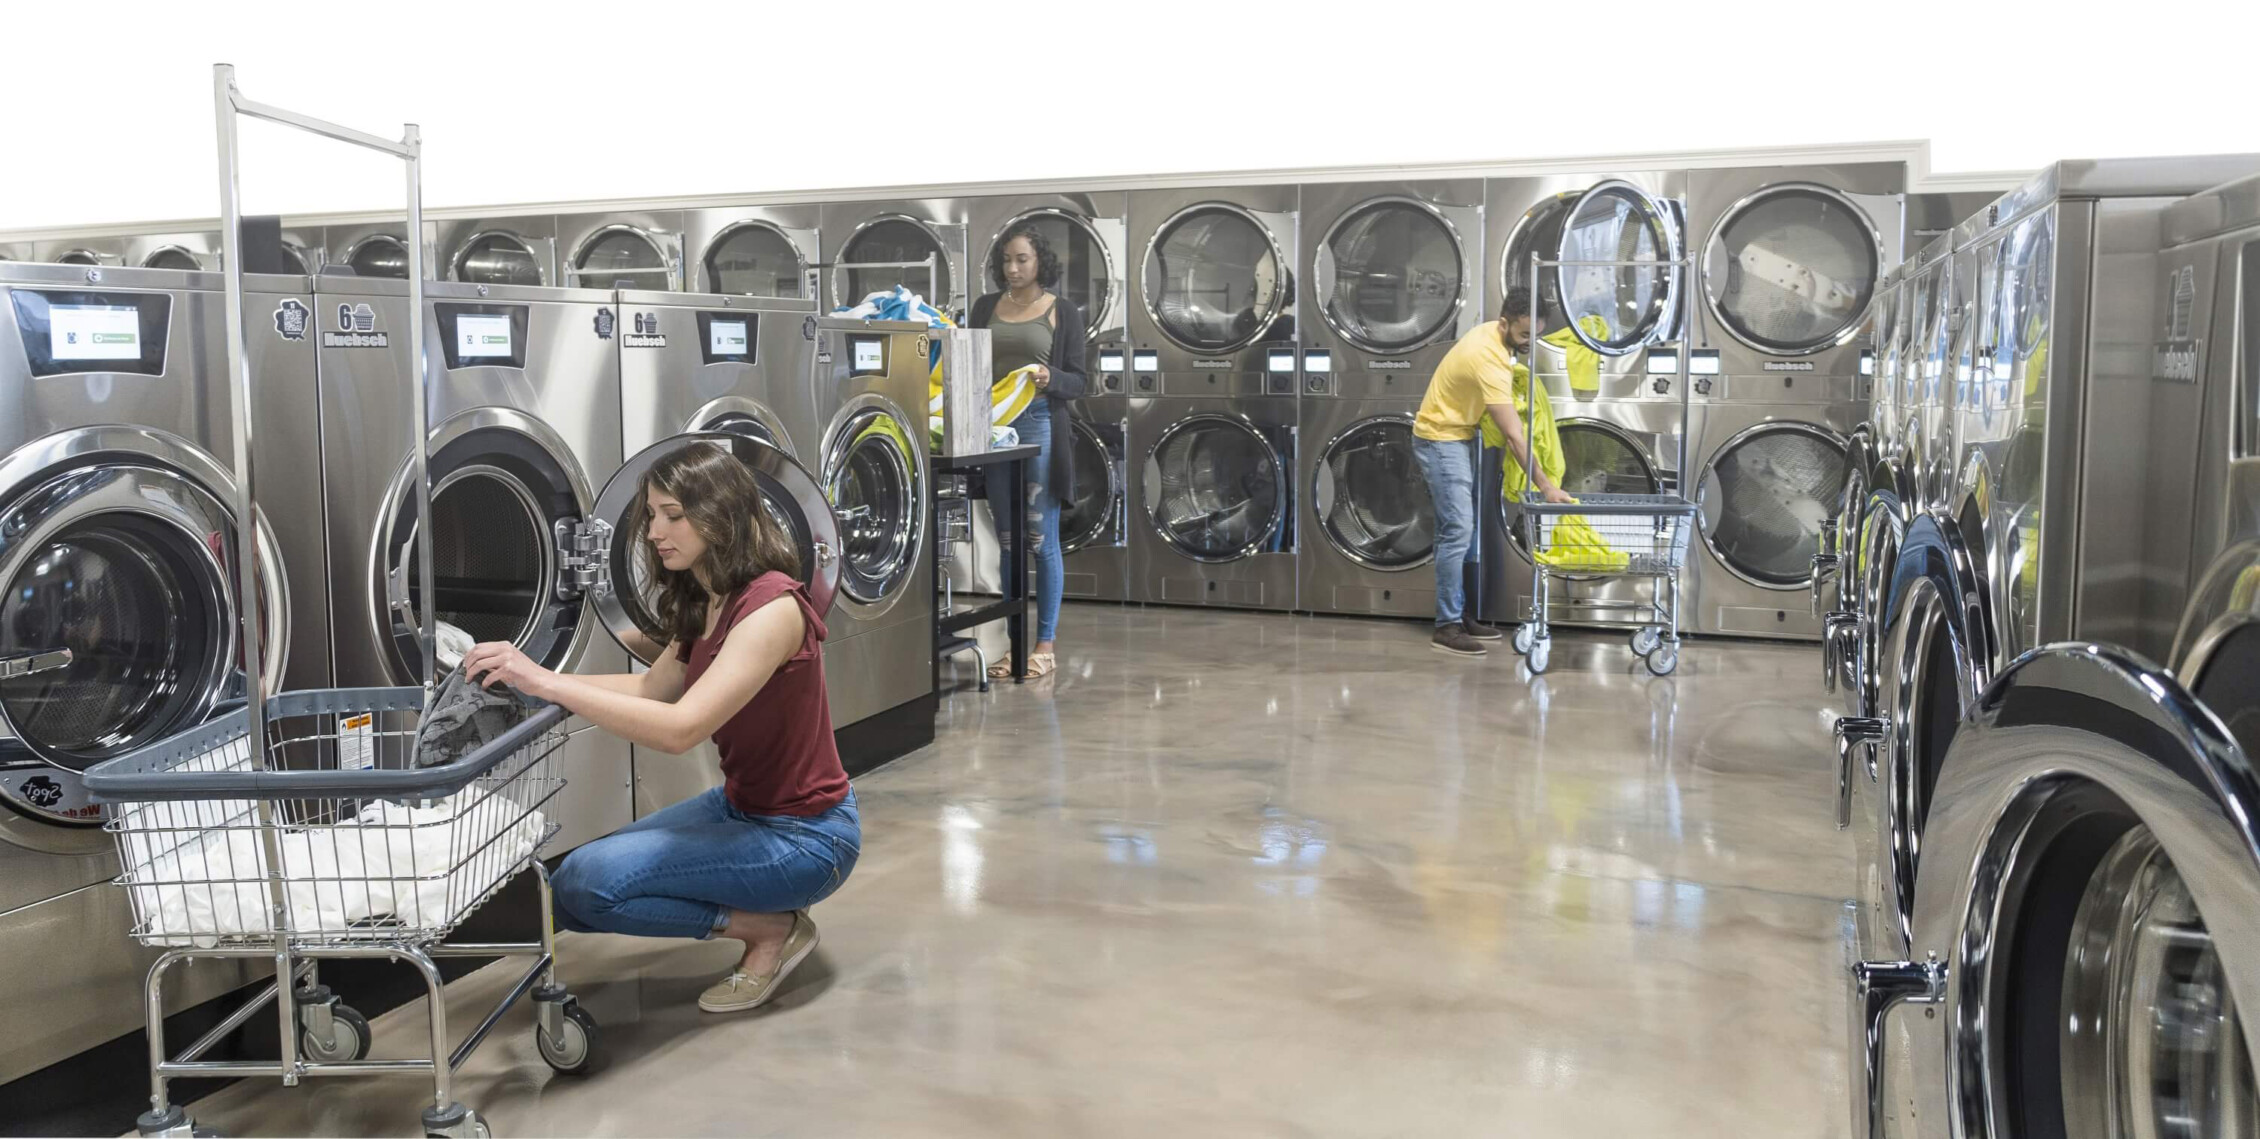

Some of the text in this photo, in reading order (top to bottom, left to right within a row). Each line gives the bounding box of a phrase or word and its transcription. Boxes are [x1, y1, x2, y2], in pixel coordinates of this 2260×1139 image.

[339, 304, 352, 330] 6
[634, 312, 643, 333] 6
[324, 332, 387, 346] Huebsch
[625, 335, 666, 346] Huebsch
[1764, 362, 1813, 370] Huebsch
